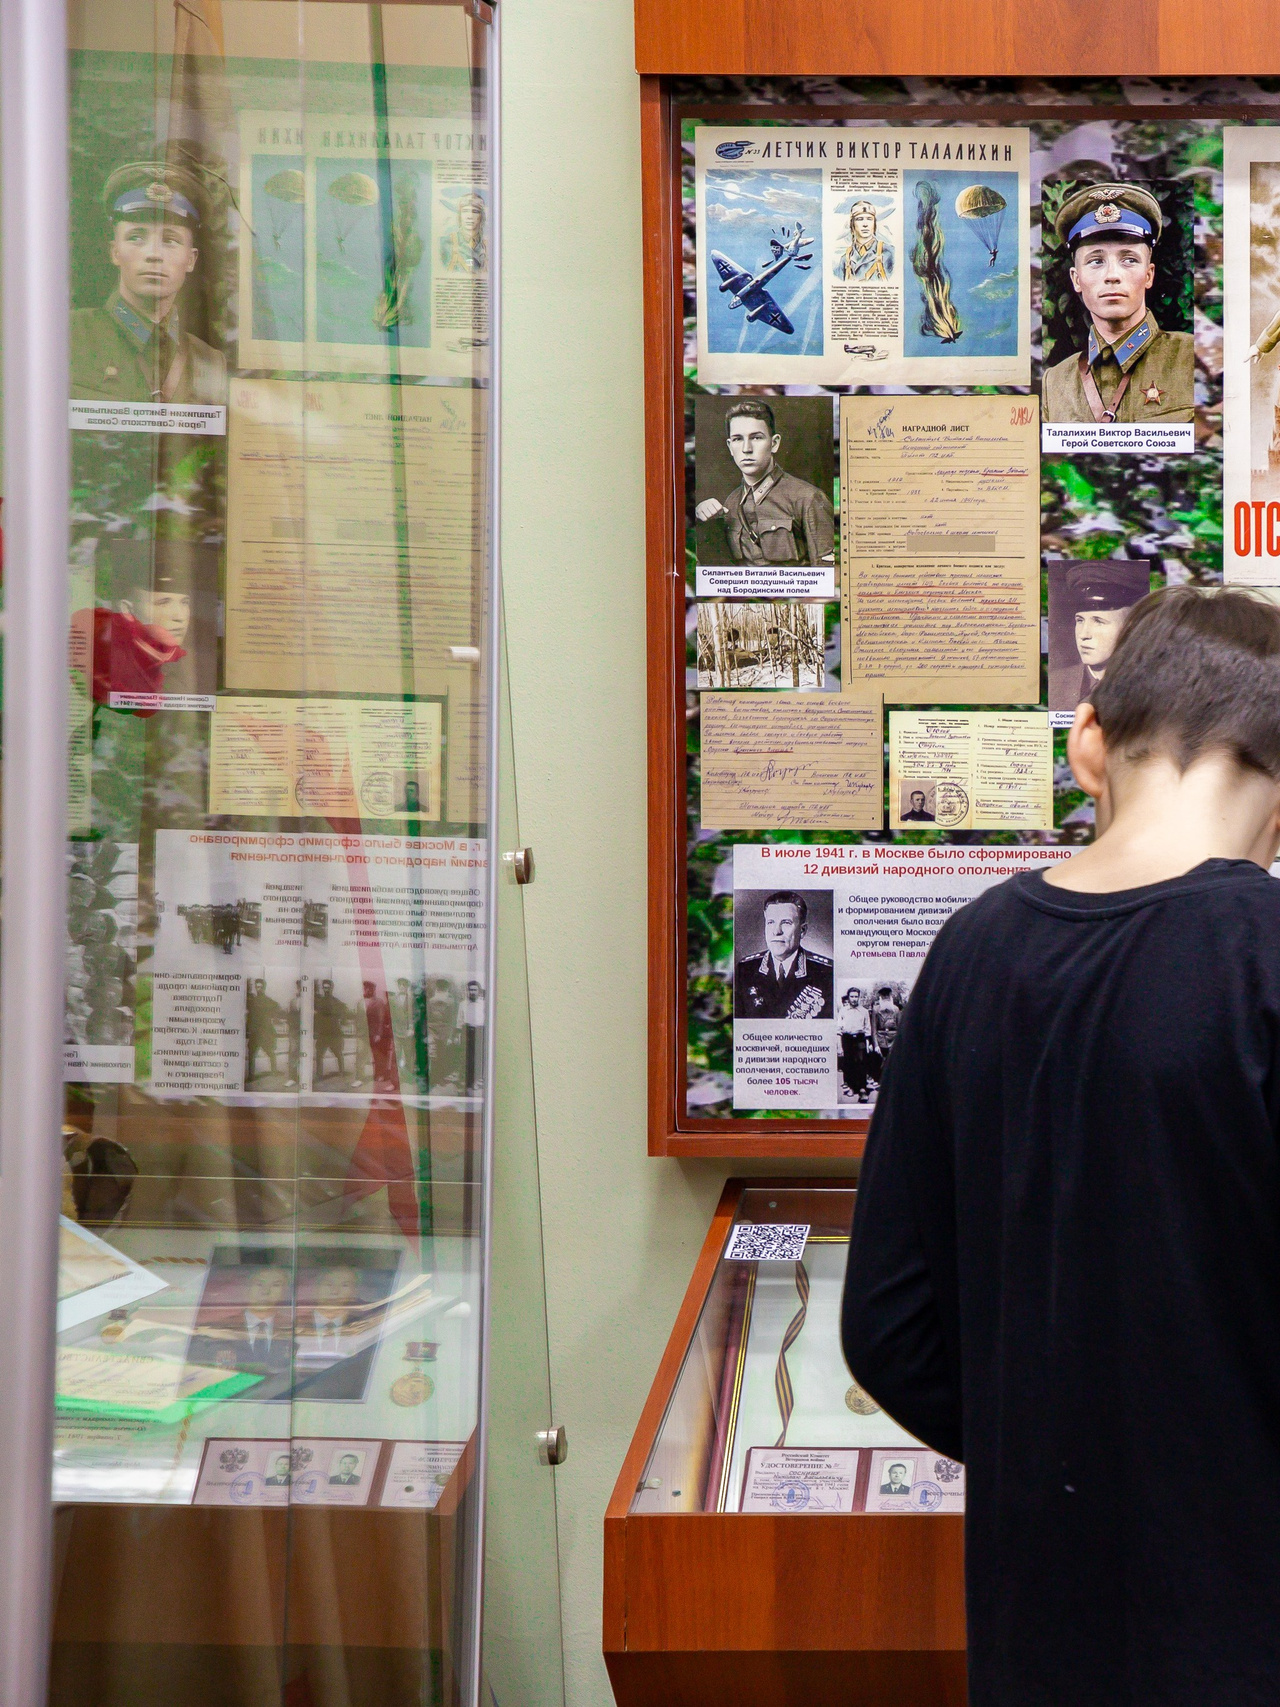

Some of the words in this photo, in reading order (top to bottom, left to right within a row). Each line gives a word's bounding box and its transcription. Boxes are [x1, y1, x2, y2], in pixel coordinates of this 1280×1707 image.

[762, 141, 827, 158] ЛЕТЧИК
[837, 142, 900, 158] ВИКТОР
[910, 142, 1011, 161] ТАЛАЛИХИН
[902, 424, 946, 432] НАГРАДНОЙ
[1099, 429, 1132, 438] Виктор
[1062, 439, 1088, 448] Герой
[1091, 439, 1143, 447] Советского
[1146, 439, 1176, 447] Союза
[709, 578, 748, 586] Совершил
[733, 586, 784, 594] Бородинским
[761, 847, 771, 858] В
[775, 849, 811, 858] июле
[816, 847, 844, 858] 1941
[849, 850, 857, 858] г.
[862, 850, 870, 858] в
[874, 848, 924, 859] Москве
[928, 848, 965, 859] было
[968, 848, 1072, 861] сформировано
[804, 863, 818, 874] 12
[821, 863, 879, 876] дивизий
[883, 866, 954, 876] народного
[849, 895, 878, 904] Общее
[846, 906, 915, 915] формированием
[918, 906, 953, 916] дивизий
[850, 950, 896, 958] Артемьева
[742, 1033, 772, 1042] Общее
